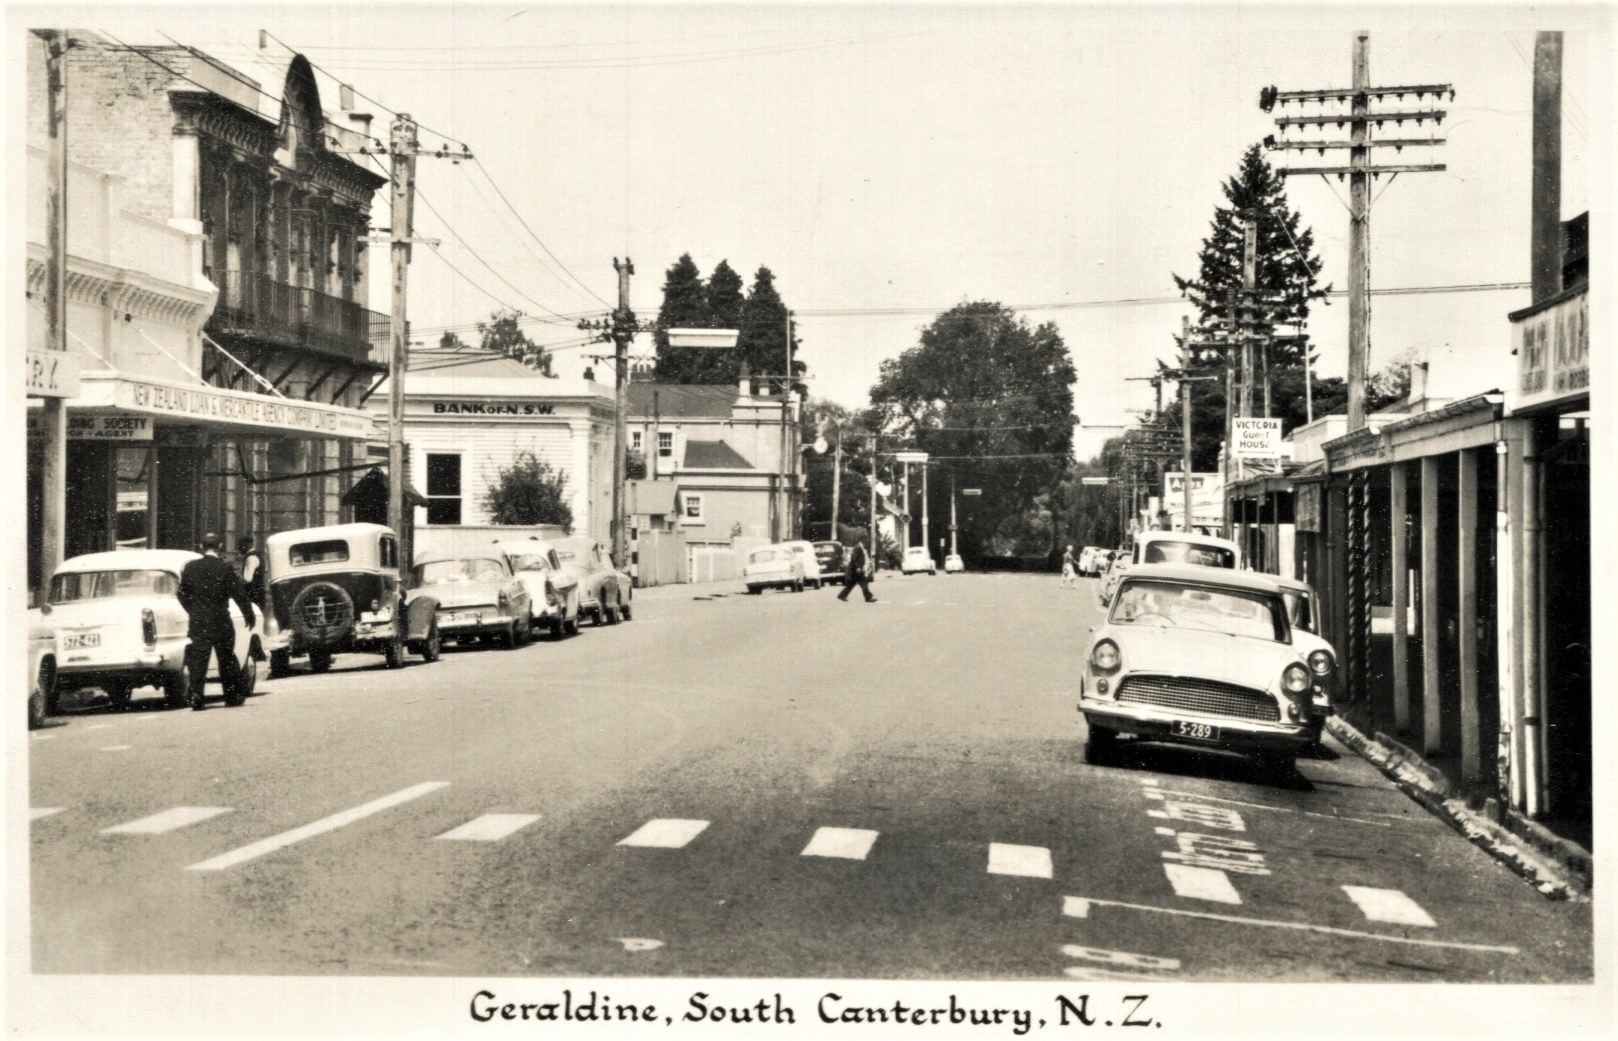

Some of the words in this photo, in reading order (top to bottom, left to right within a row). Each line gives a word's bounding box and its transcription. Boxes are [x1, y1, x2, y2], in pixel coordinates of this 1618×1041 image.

[133, 382, 150, 407] NEW
[153, 386, 187, 413] ZEALAND
[433, 403, 485, 414] BANK
[505, 404, 556, 415] N.S.W.
[103, 417, 147, 430] SOCIETY
[1236, 421, 1278, 429] VICTORIA
[94, 429, 134, 437] AGENT
[1180, 721, 1211, 738] 5-289
